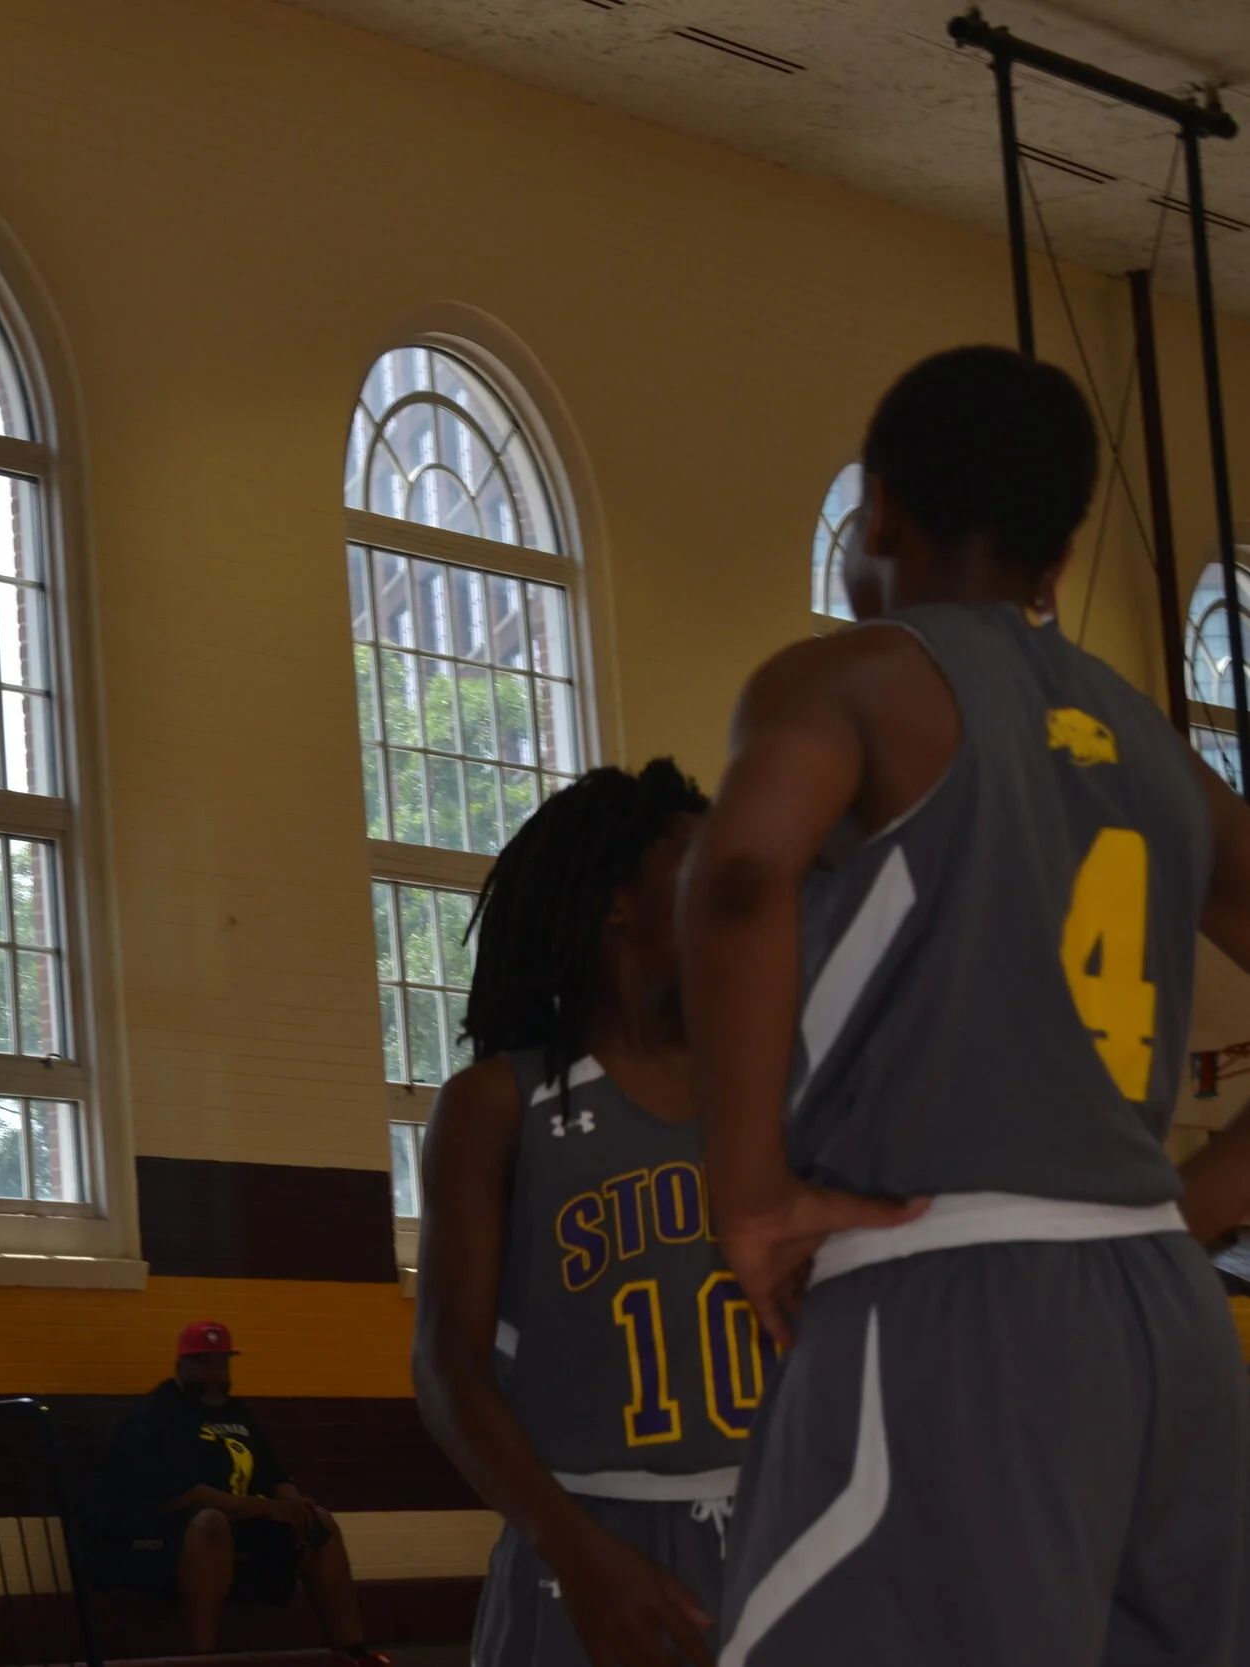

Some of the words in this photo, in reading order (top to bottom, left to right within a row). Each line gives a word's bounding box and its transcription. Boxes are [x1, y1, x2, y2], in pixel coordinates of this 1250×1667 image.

[1060, 826, 1157, 1102] 4
[556, 1161, 719, 1292] STO
[612, 1271, 783, 1447] 10
